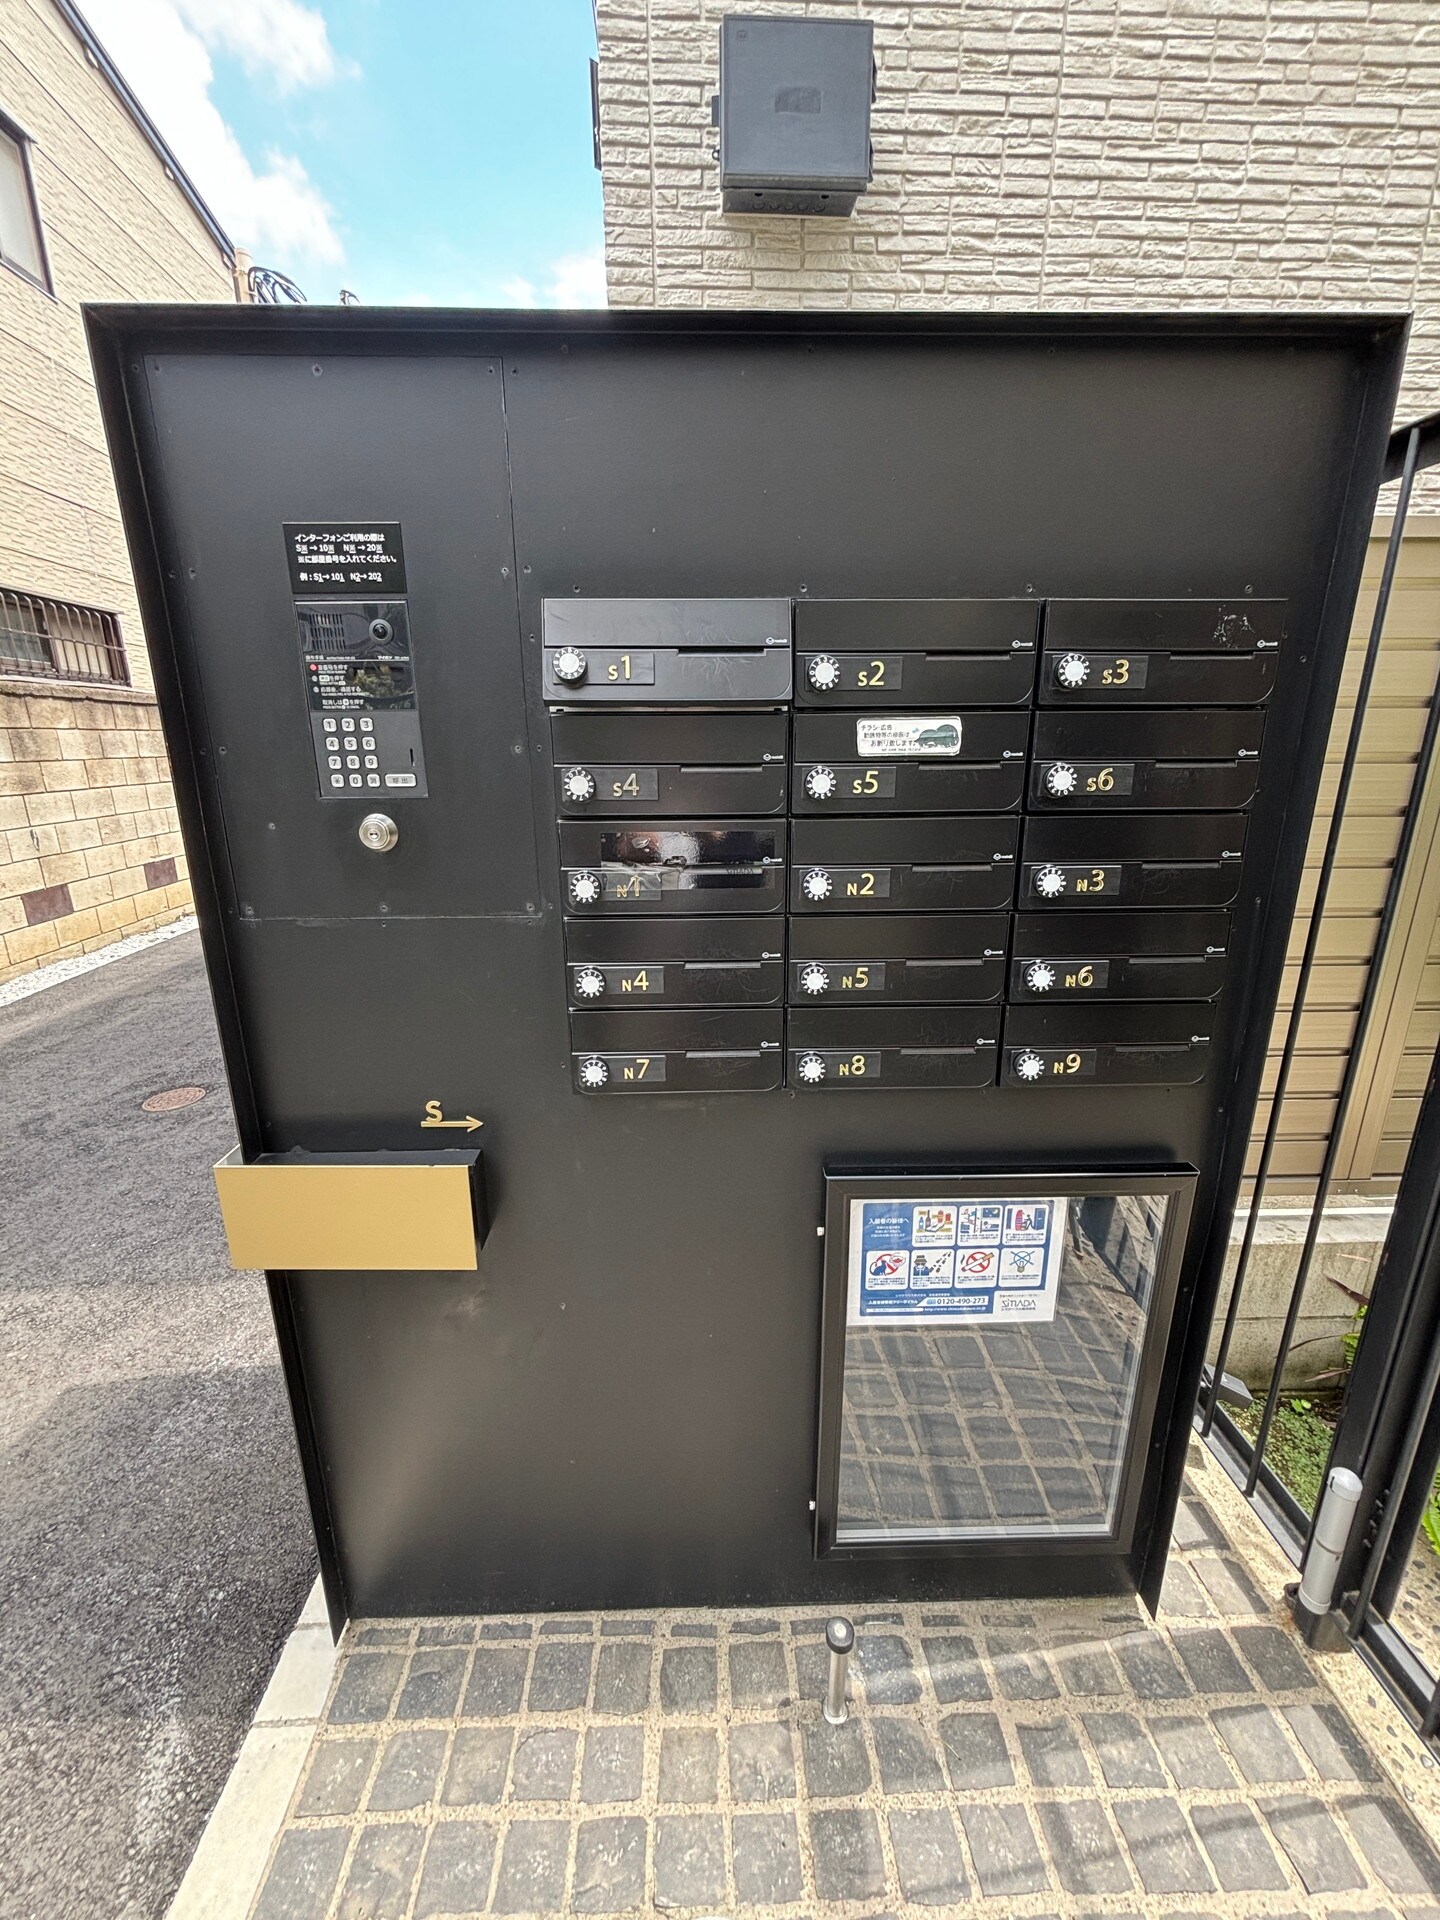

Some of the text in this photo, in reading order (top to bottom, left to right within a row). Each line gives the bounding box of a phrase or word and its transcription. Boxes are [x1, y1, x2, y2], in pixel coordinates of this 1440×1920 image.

[847, 873, 875, 896] N2
[1076, 869, 1105, 892] N3
[621, 971, 649, 992] N4
[842, 968, 869, 988] N5
[1065, 965, 1094, 987] N6
[624, 1059, 650, 1080] N7
[839, 1055, 866, 1076] N8
[1053, 1053, 1081, 1074] N9
[426, 1100, 443, 1122] S
